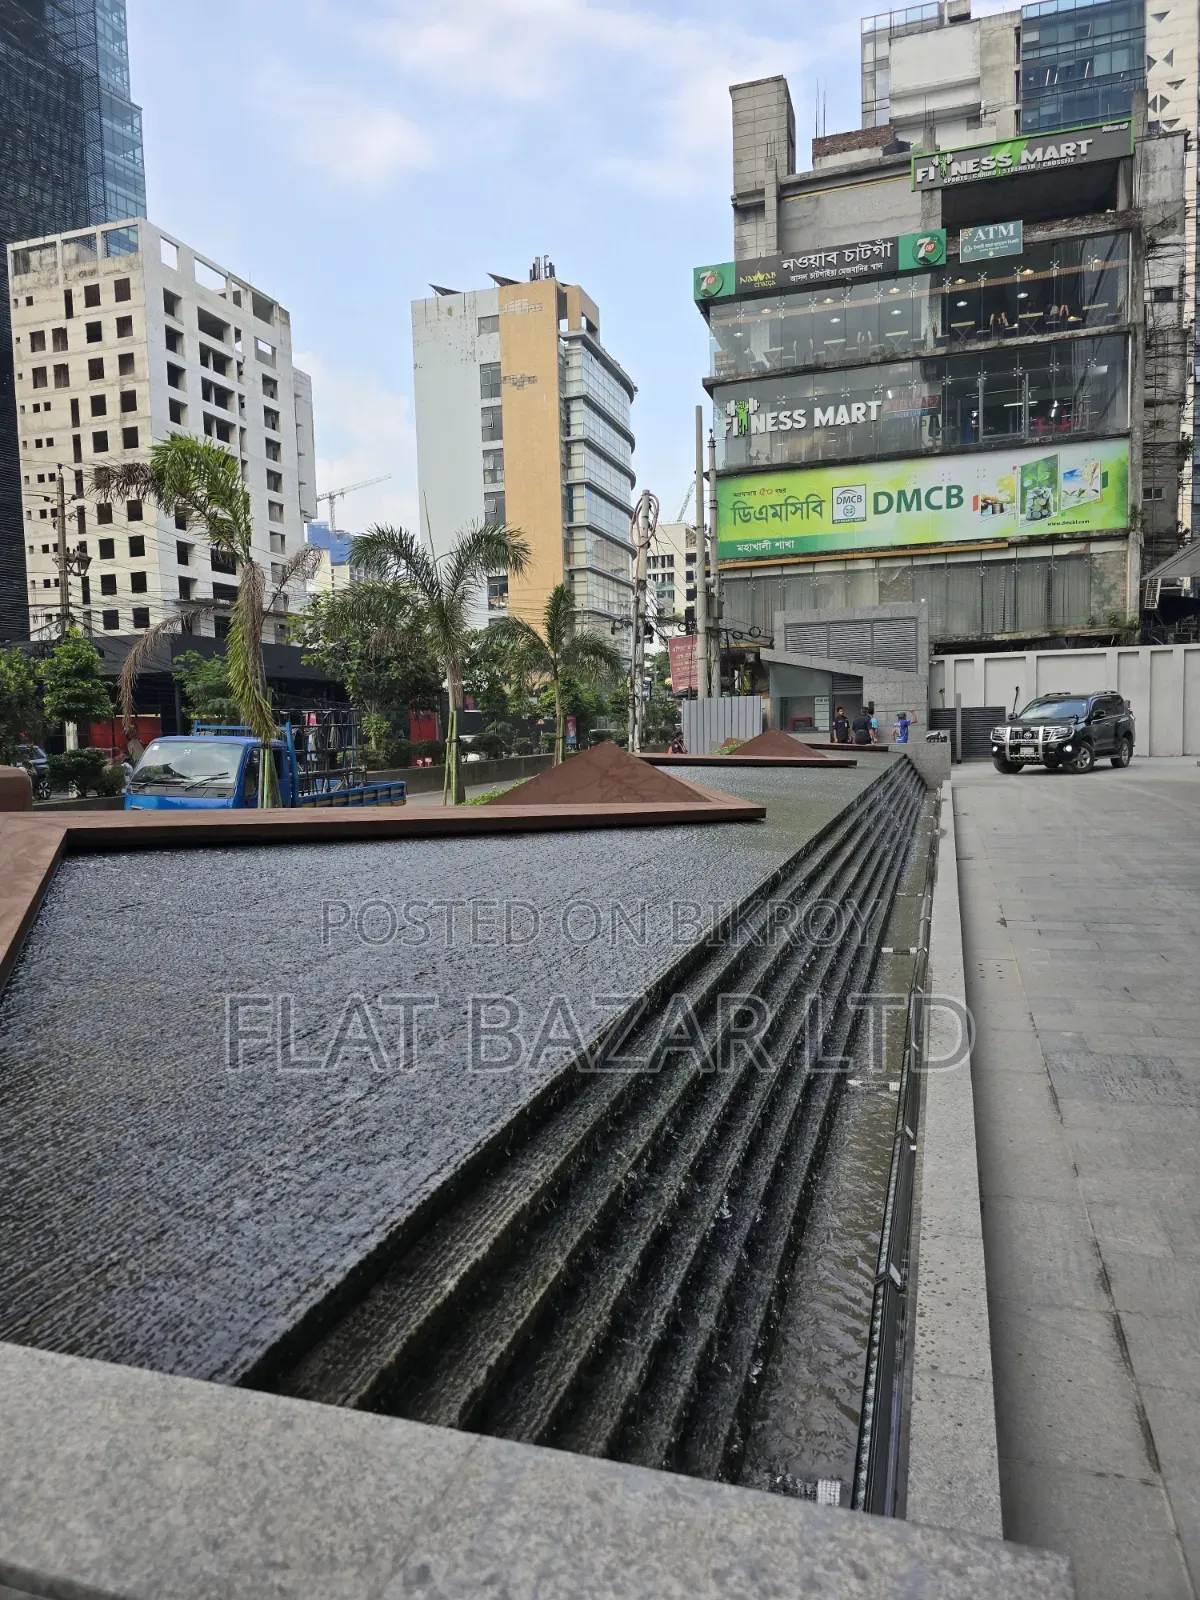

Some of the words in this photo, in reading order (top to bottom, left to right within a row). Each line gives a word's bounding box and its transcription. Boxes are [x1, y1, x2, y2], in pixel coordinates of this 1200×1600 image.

[1020, 138, 1093, 164] MART
[943, 174, 968, 184] SPORTS
[972, 169, 997, 179] CARDIO
[1002, 163, 1036, 174] STRENGTH
[1042, 156, 1075, 168] CROSSFIT
[974, 223, 1015, 241] ATM
[781, 251, 840, 272] নওয়াব
[842, 239, 894, 263] চাটগাঁ
[812, 400, 882, 428] MART
[760, 488, 773, 496] ৫০
[836, 495, 862, 504] DMCB
[873, 484, 964, 515] DMCB
[731, 494, 826, 526] ডিএমসিবি
[736, 540, 771, 553] মহাখালী
[774, 539, 795, 550] শাখা
